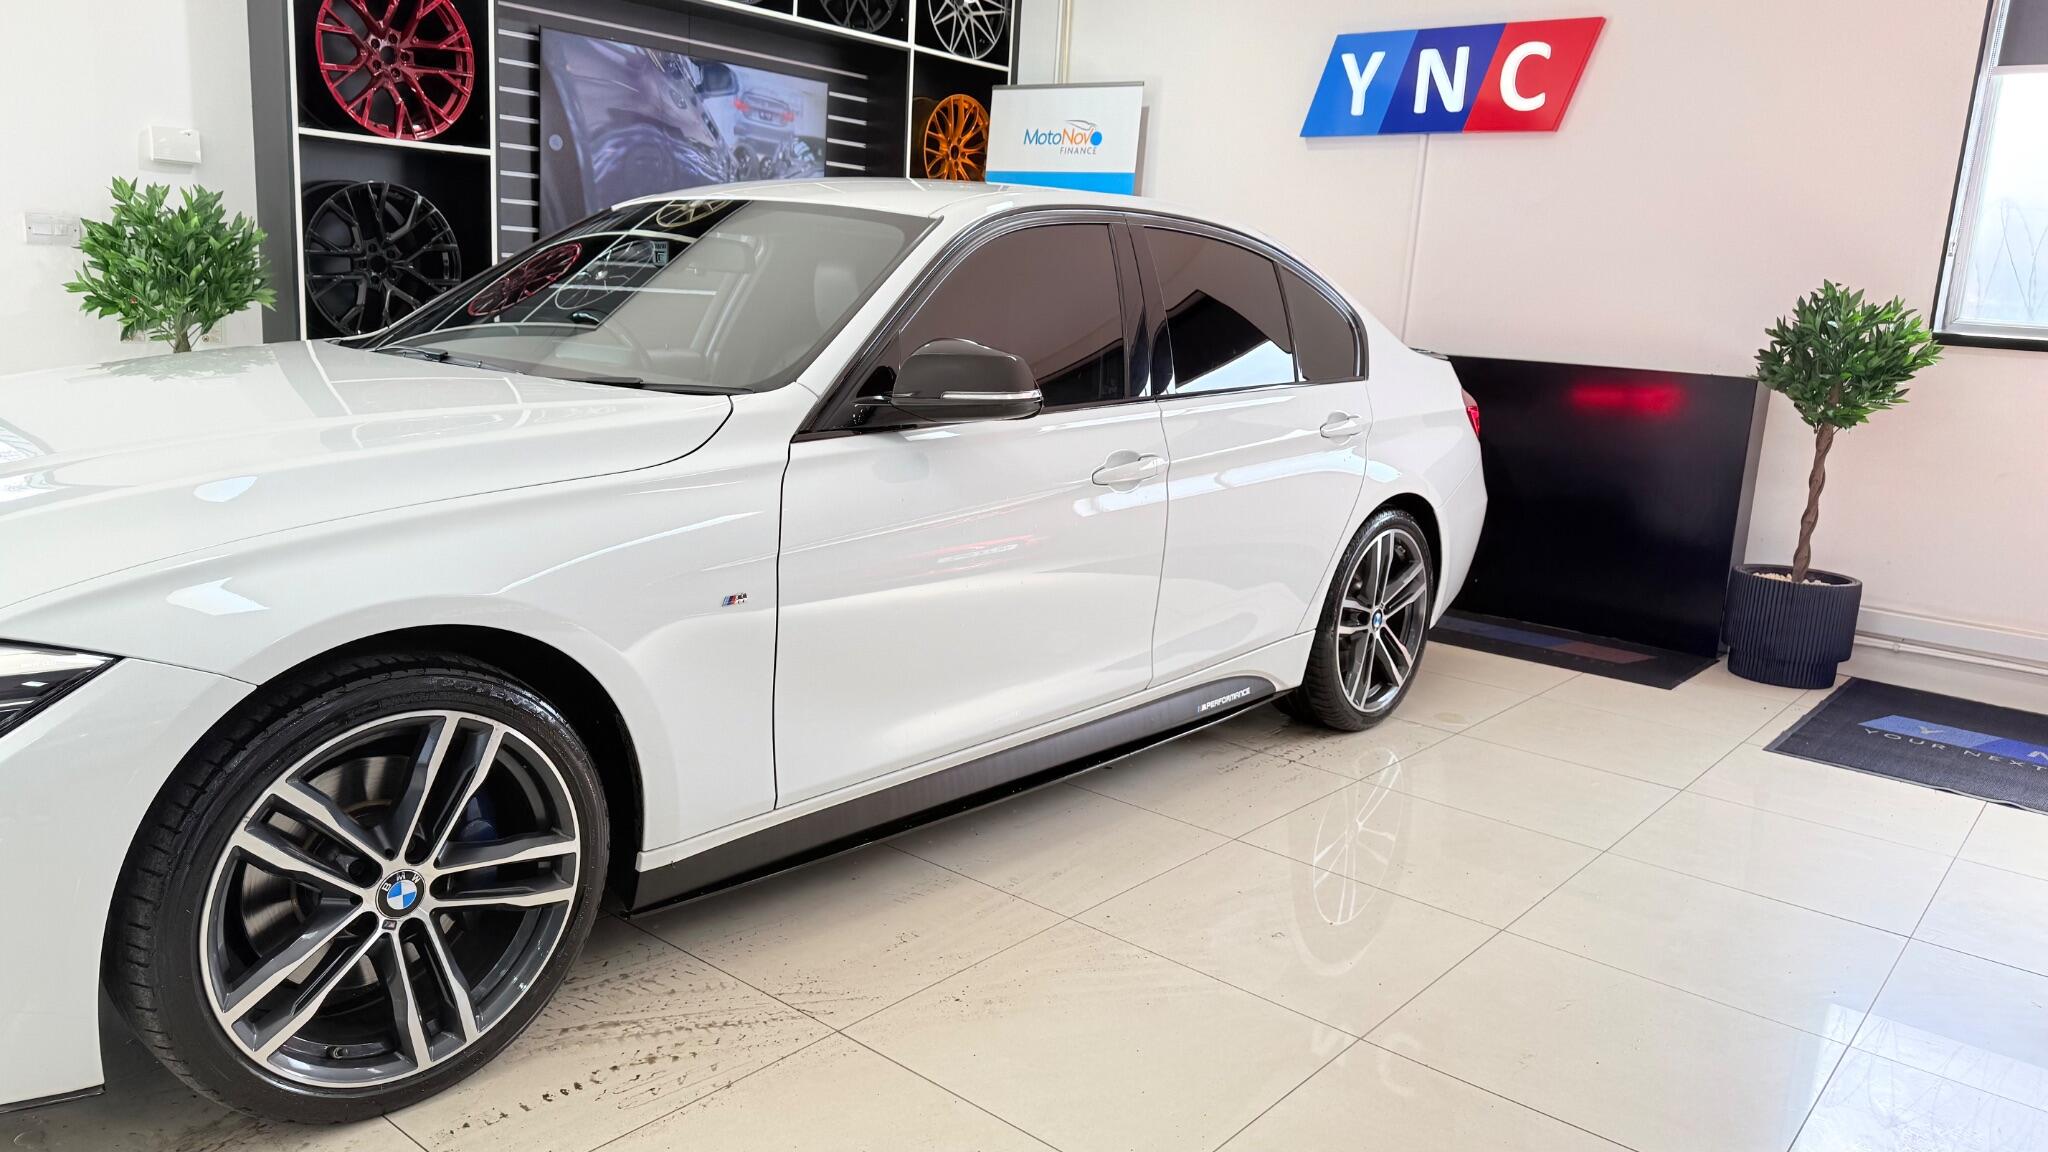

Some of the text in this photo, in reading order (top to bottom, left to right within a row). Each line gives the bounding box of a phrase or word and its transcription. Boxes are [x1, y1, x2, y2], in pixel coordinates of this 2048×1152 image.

[1341, 41, 1552, 116] YNC
[1023, 127, 1103, 146] MotoNovo
[1060, 146, 1098, 155] FINANCE
[1864, 727, 2048, 771] YOUR NEXT
[382, 871, 421, 892] BMW
